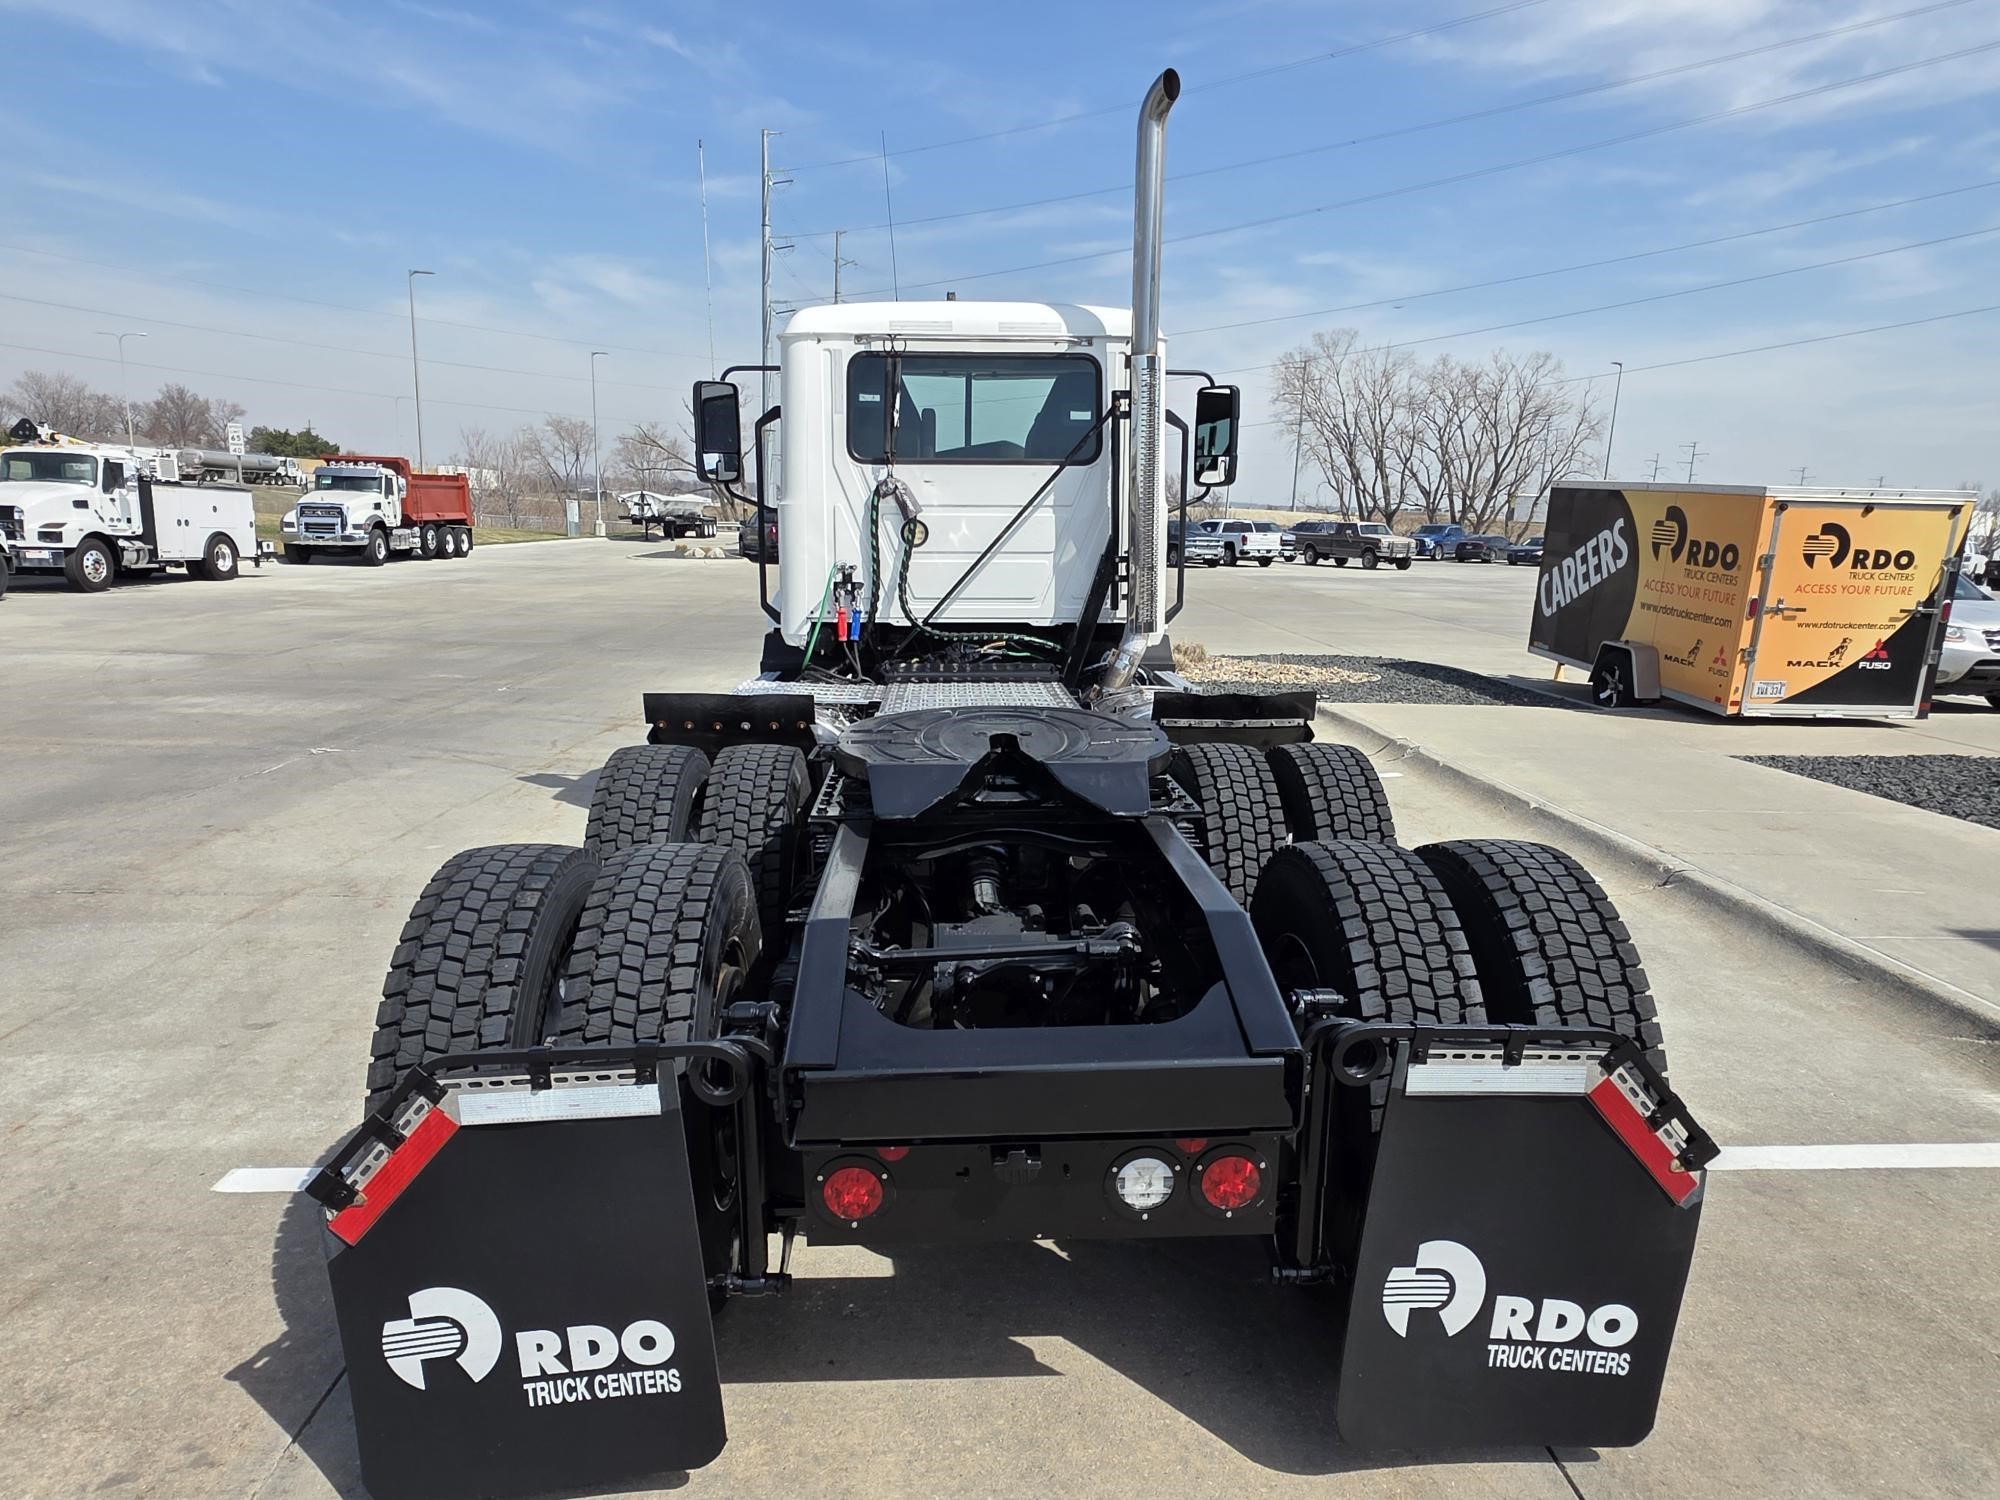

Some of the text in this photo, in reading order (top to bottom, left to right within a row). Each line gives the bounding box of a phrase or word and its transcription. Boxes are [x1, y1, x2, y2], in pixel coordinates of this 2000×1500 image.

[1686, 539, 1740, 571] RDO
[1851, 549, 1915, 570] RDO
[1540, 517, 1628, 617] CAREERS
[1684, 567, 1738, 586] TRUCK CENTERS
[1848, 571, 1915, 582] TRUCK CENTERS
[1644, 578, 1737, 607] ACCESS YOUR FUTURE
[1795, 583, 1913, 596] ACCESS YOUR FUTURE
[1640, 601, 1732, 629] www.rdotruckcenter.com
[1797, 620, 1896, 631] www.rdotruckcenter.com
[1664, 654, 1696, 668] MACK
[1786, 660, 1841, 668] MACK
[1858, 661, 1892, 670] FUSO
[1708, 666, 1729, 678] FUSO
[1489, 1295, 1639, 1348] RDO
[515, 1319, 675, 1378] RDO
[1487, 1344, 1631, 1377] TRUCK CENTERS
[523, 1368, 682, 1408] TRUCK CENTERS
